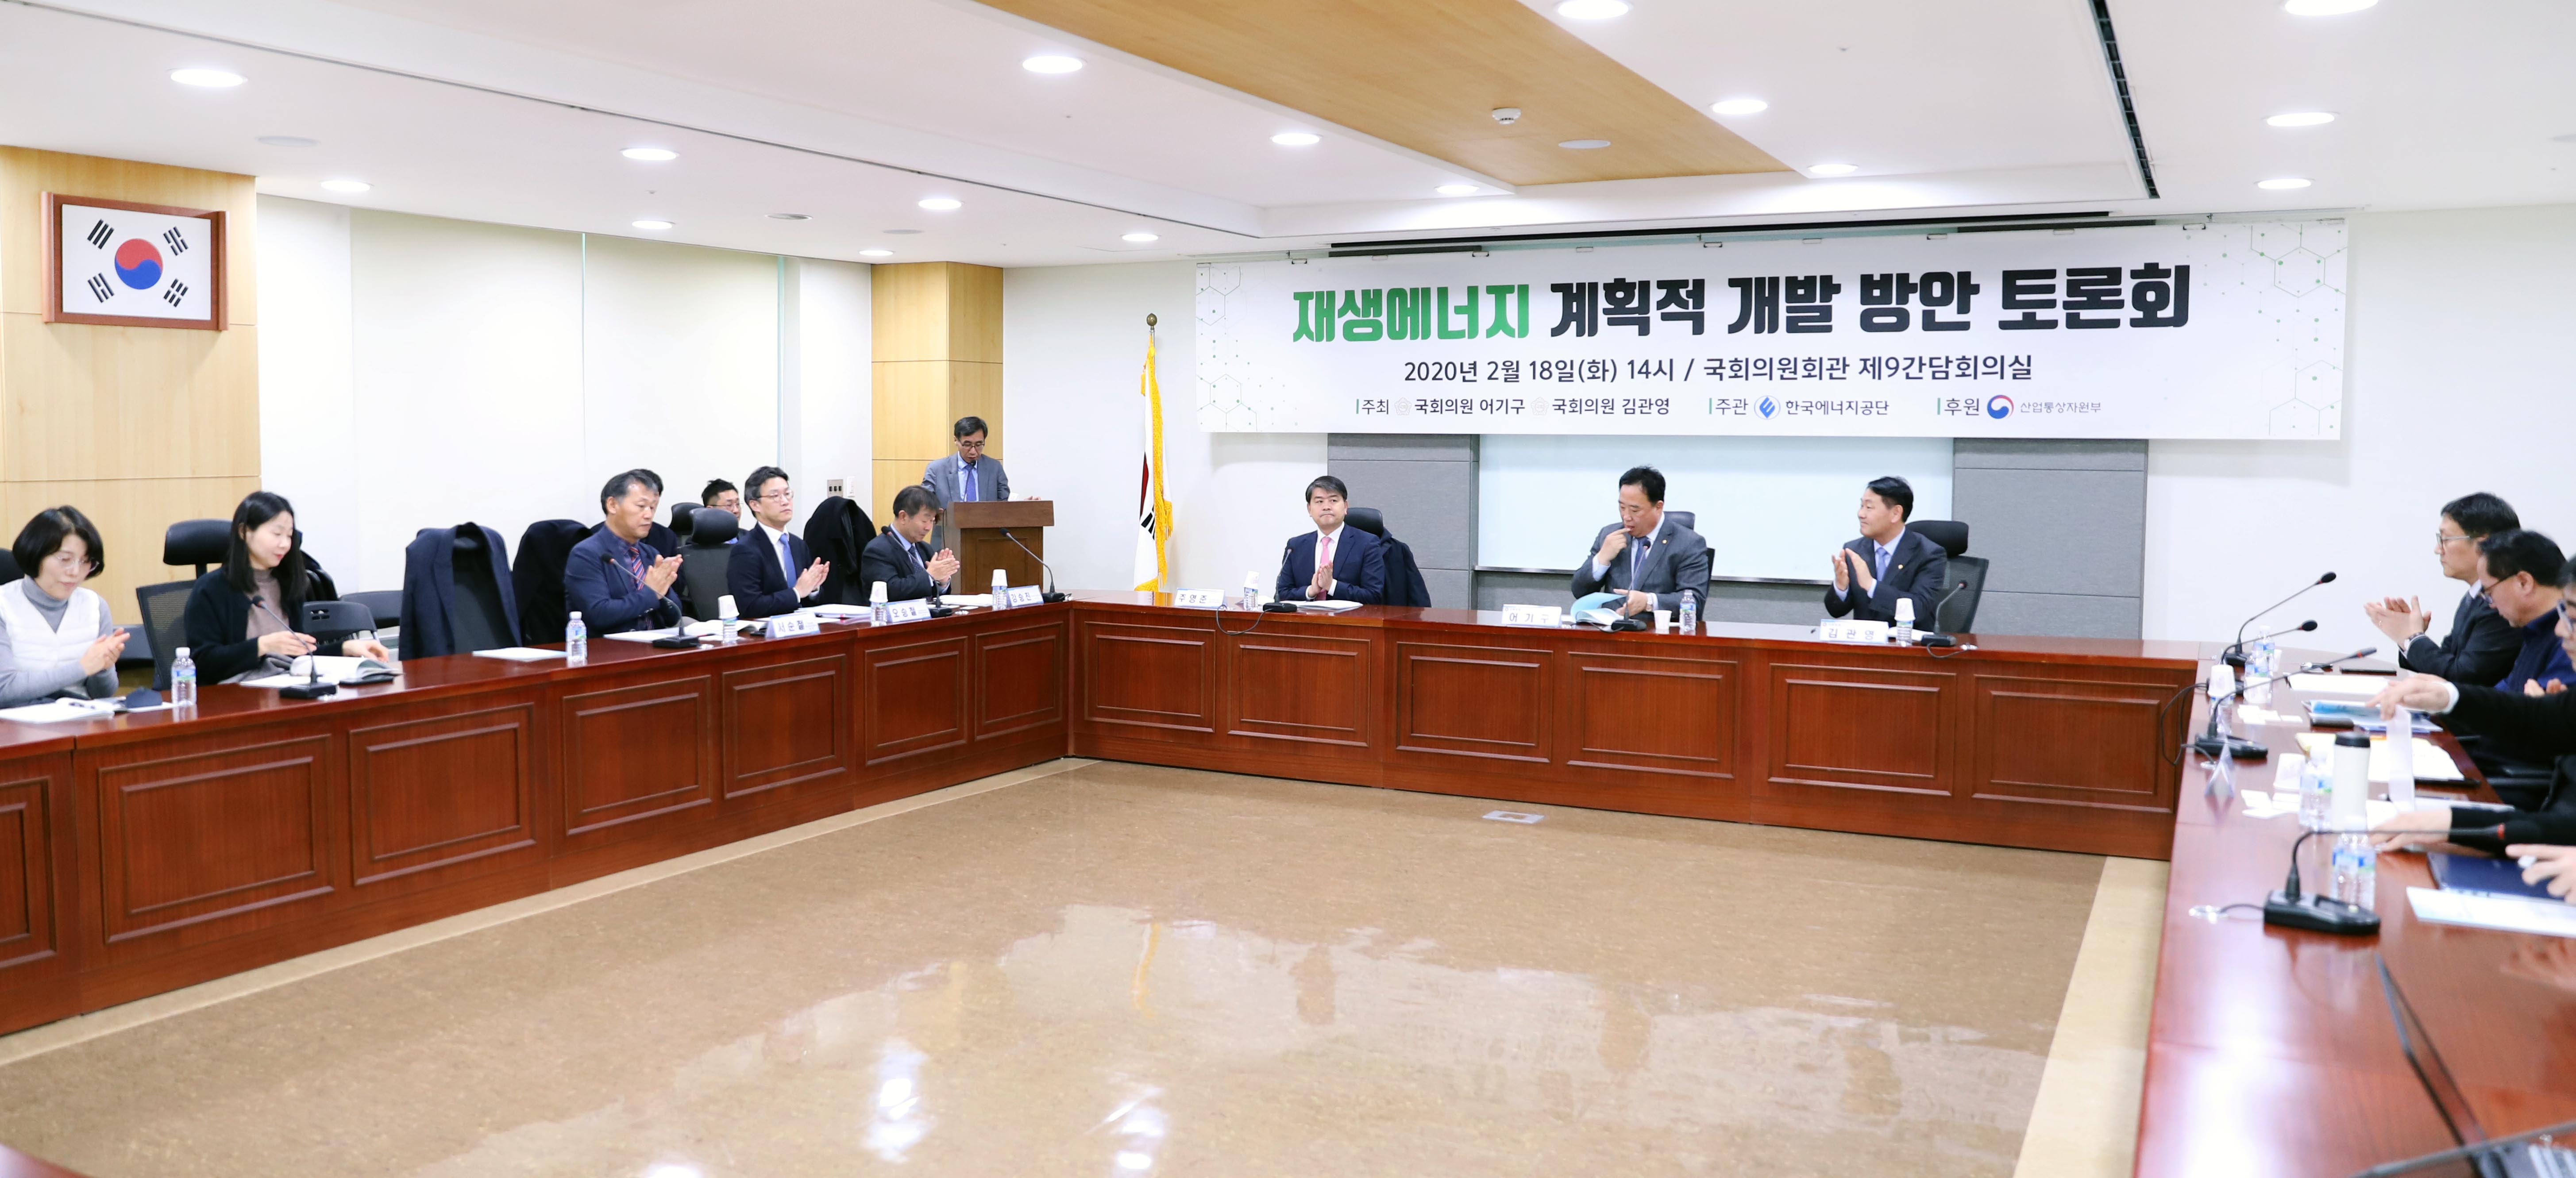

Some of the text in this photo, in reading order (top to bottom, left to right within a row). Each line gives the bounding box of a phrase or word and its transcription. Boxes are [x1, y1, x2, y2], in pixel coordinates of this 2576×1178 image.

[1293, 262, 2190, 342] 재생에너지 계획적 개발 방안 토론회
[1404, 354, 2032, 383] 2020년 2월 18일(화) 14시 / 국회의원회관 제9간담회의실
[1361, 398, 1525, 415] 주최 국회의원 어기구
[1552, 398, 1670, 415] 국회의원 김관영
[1715, 398, 1748, 415] 주관
[1785, 400, 1889, 416] 한국에너지공단
[1944, 398, 1980, 416] 후원
[2021, 402, 2102, 413] 산업통상자원부
